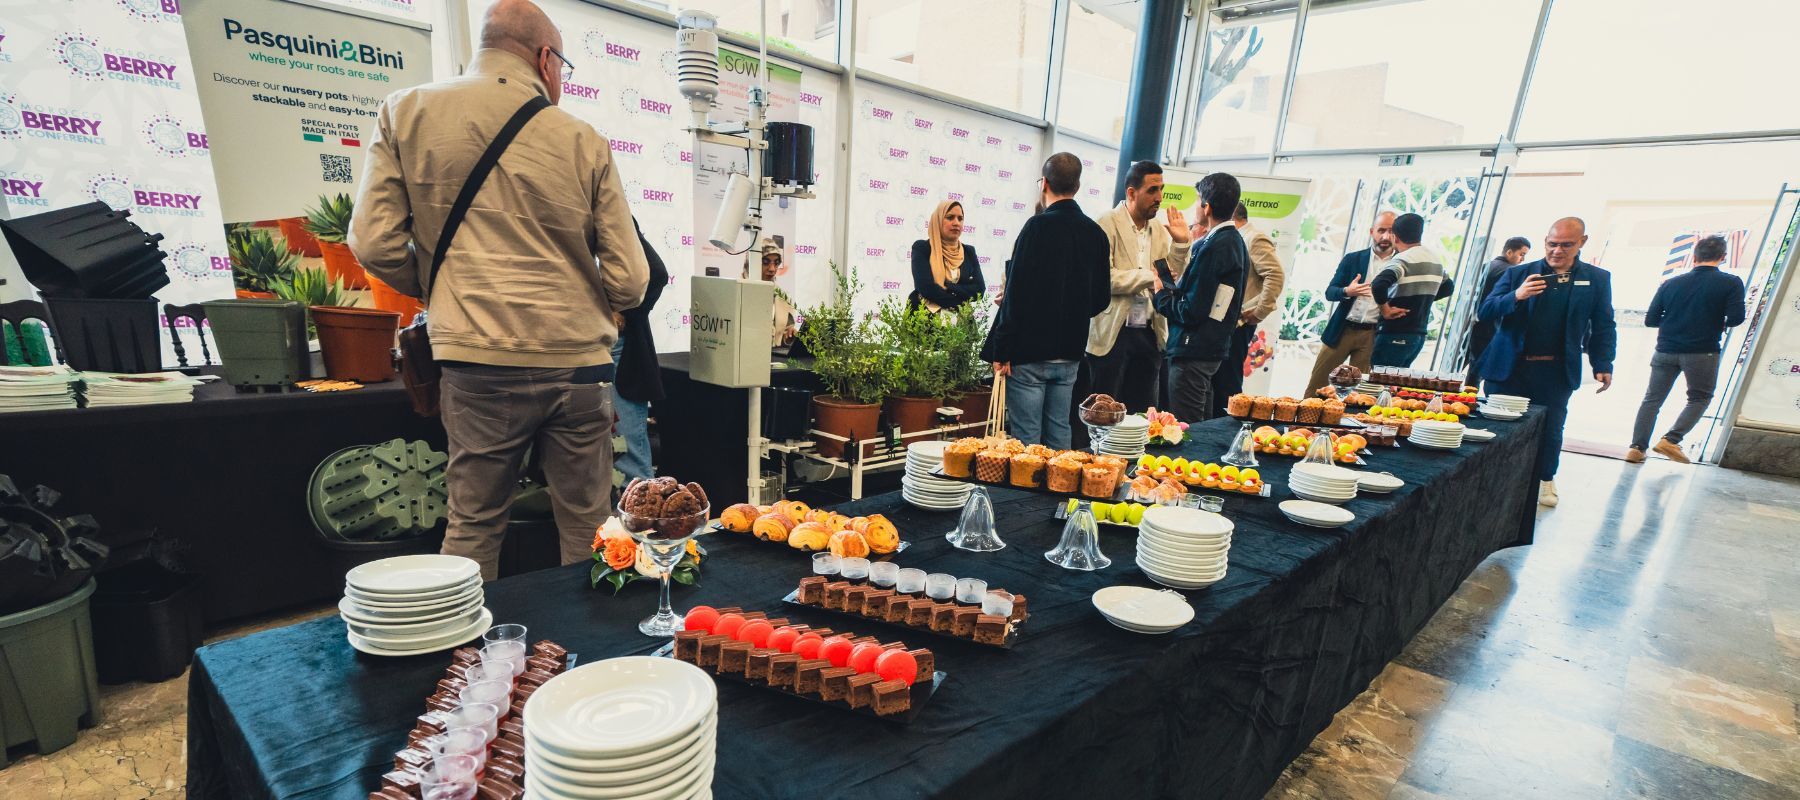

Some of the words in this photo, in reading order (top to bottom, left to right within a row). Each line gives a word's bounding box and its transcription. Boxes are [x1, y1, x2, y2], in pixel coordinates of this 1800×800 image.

[223, 18, 403, 69] Pasquini&Bini
[606, 42, 640, 60] BERRY
[104, 53, 177, 81] BERRY
[249, 52, 286, 66] where
[289, 59, 314, 69] your
[317, 63, 345, 76] roots
[347, 69, 365, 79] are
[367, 72, 390, 83] safe
[107, 72, 182, 90] CONFERENCE
[213, 73, 261, 88] Discover
[263, 82, 281, 91] our
[282, 85, 323, 99] nursery
[352, 94, 379, 107] highly
[563, 81, 600, 100] BERRY
[252, 93, 306, 108] stackable
[308, 102, 327, 111] and
[640, 98, 672, 115] BERRY
[873, 108, 893, 120] BERRY
[22, 111, 102, 136] BERRY
[301, 118, 336, 129] SPECIAL
[337, 123, 359, 132] POTS
[914, 118, 934, 129] BERRY
[27, 129, 106, 146] CONFERENCE
[302, 126, 326, 135] MADE
[339, 130, 360, 140] ITALY
[953, 128, 969, 138] BERRY
[610, 139, 644, 155] BERRY
[987, 136, 1001, 145] BERRY
[890, 148, 908, 158] BERRY
[930, 157, 947, 166] BERRY
[965, 164, 981, 172] BERRY
[870, 180, 888, 190] BERRY
[911, 187, 928, 195] BERRY
[134, 190, 202, 210] BERRY
[643, 189, 674, 203] BERRY
[137, 206, 205, 218] CONFERENCE
[886, 217, 904, 225] BERRY
[867, 248, 885, 257] BERRY
[883, 282, 900, 290] BERRY
